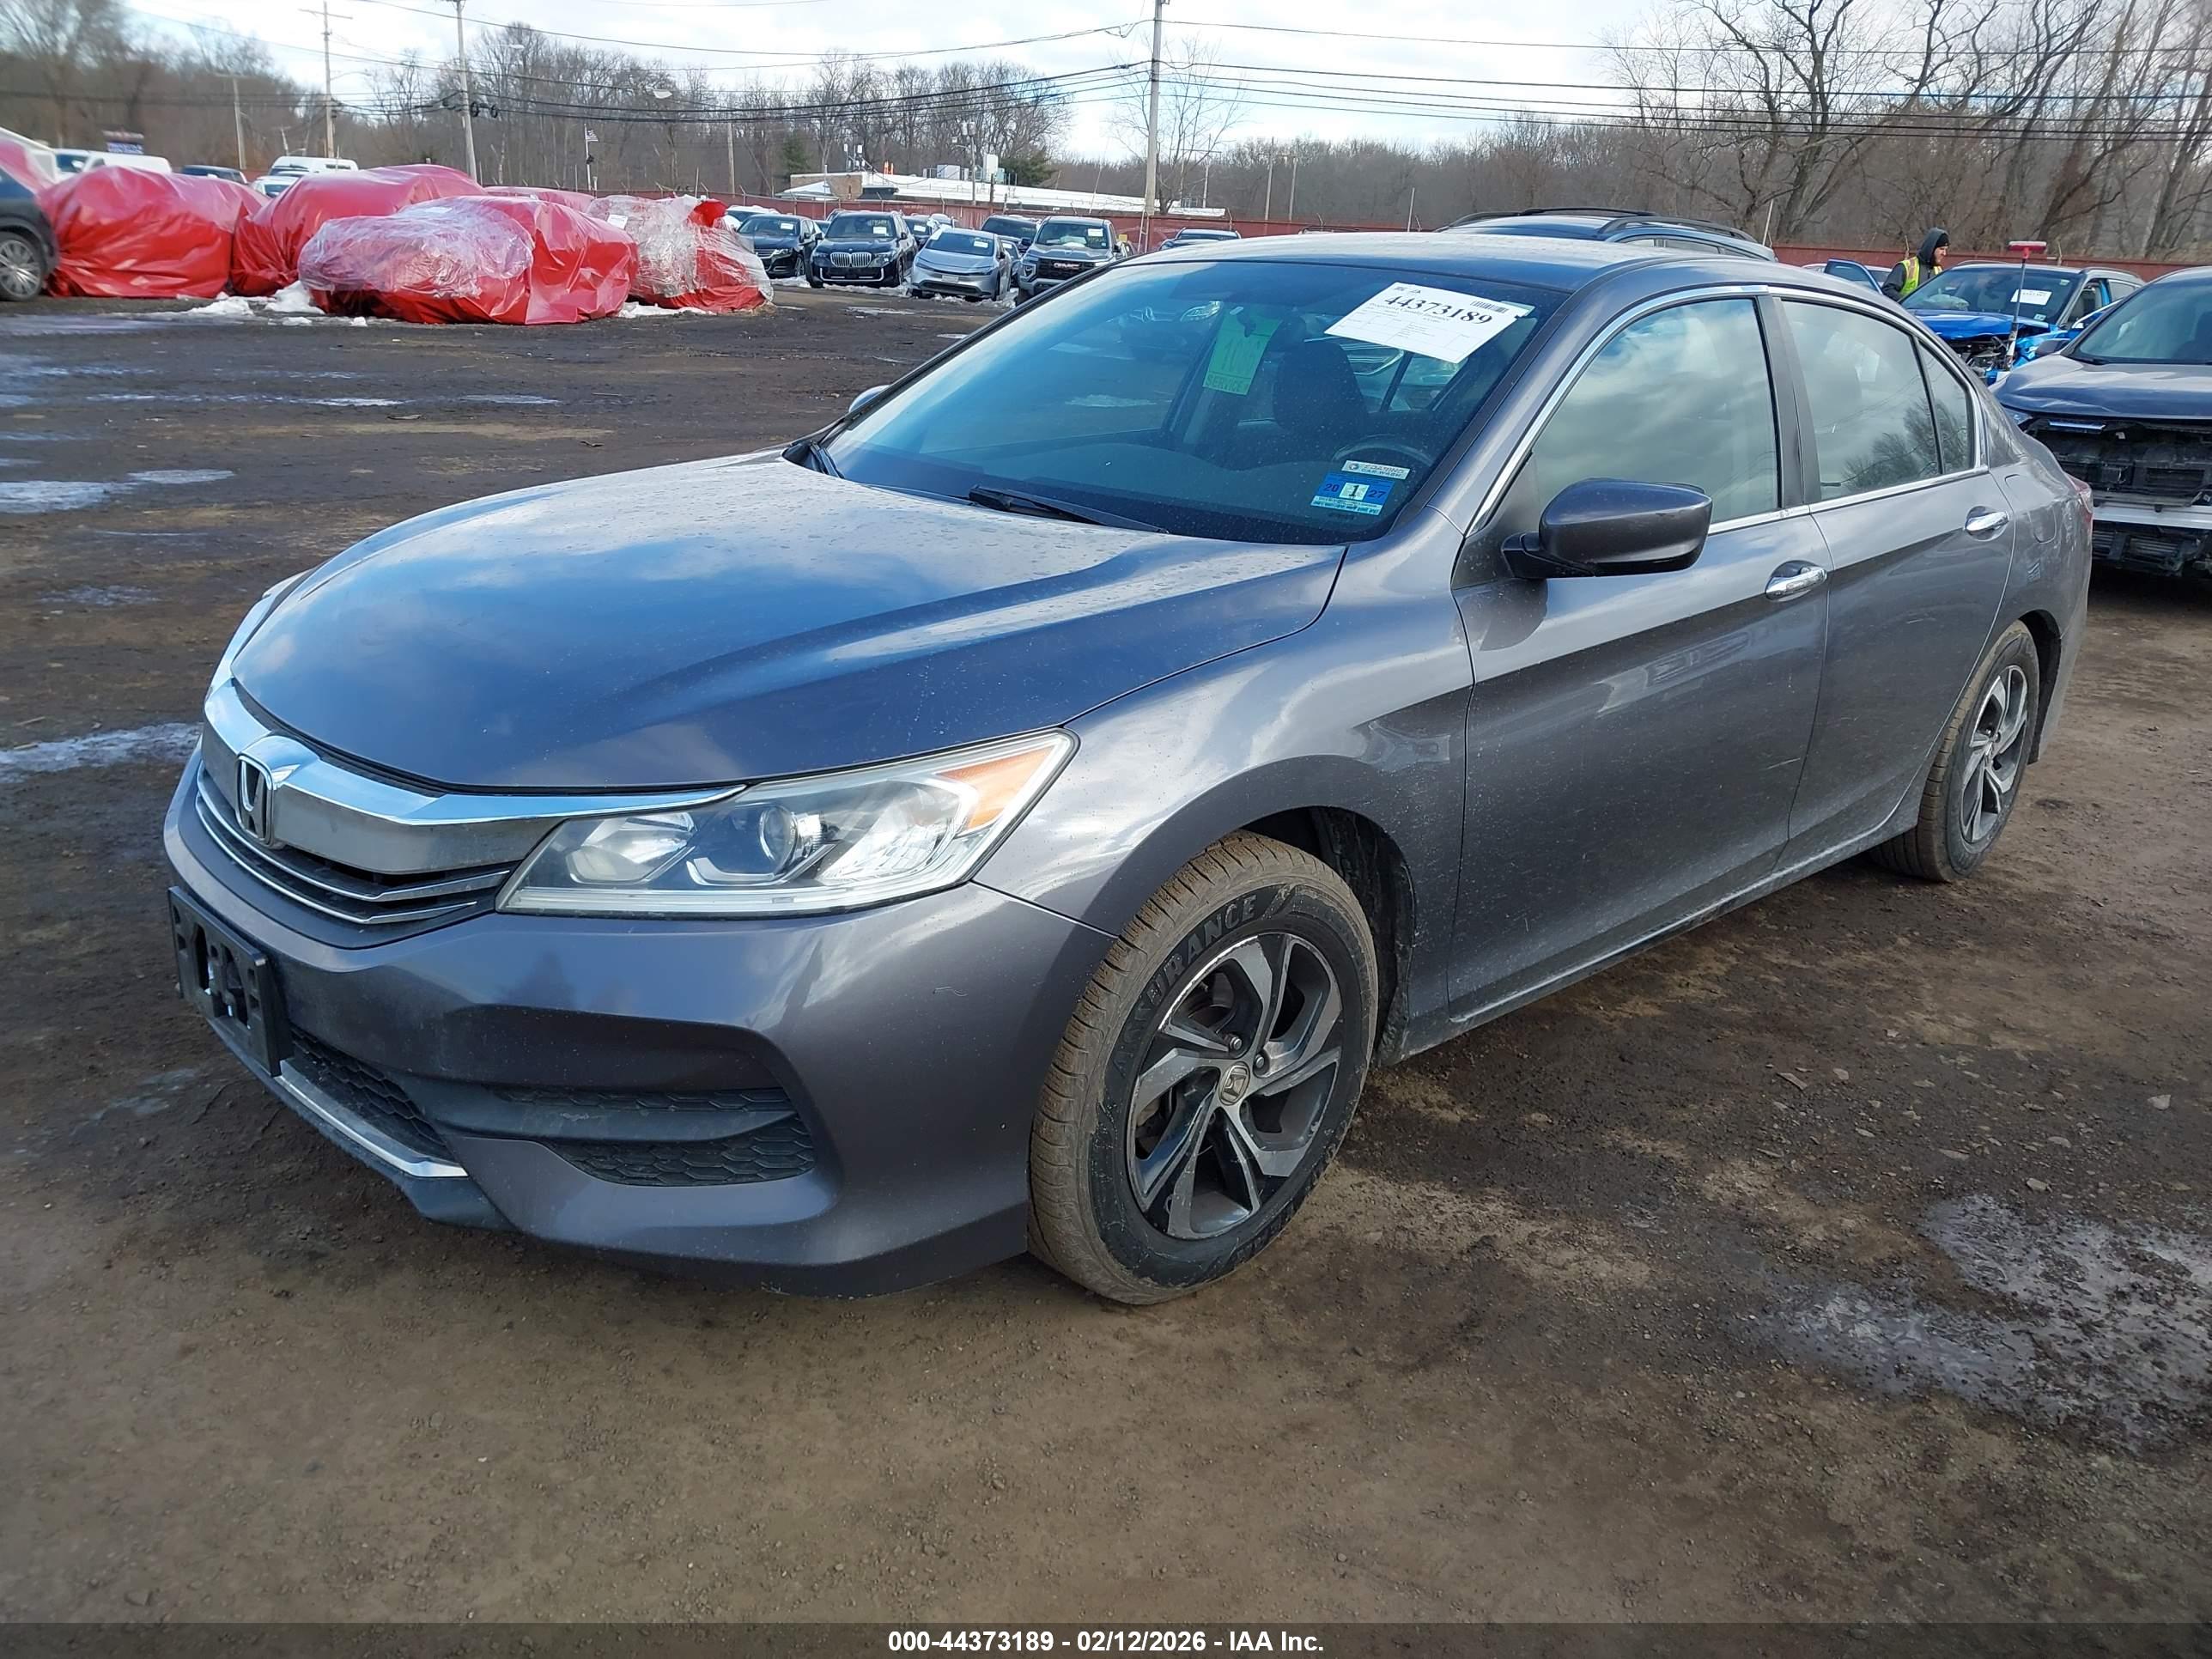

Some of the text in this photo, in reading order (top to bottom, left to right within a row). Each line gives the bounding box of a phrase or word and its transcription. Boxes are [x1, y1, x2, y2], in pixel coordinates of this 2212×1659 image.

[1053, 262, 1080, 270] GMC
[1384, 295, 1492, 324] 44373189
[1324, 483, 1387, 498] 20 1 27
